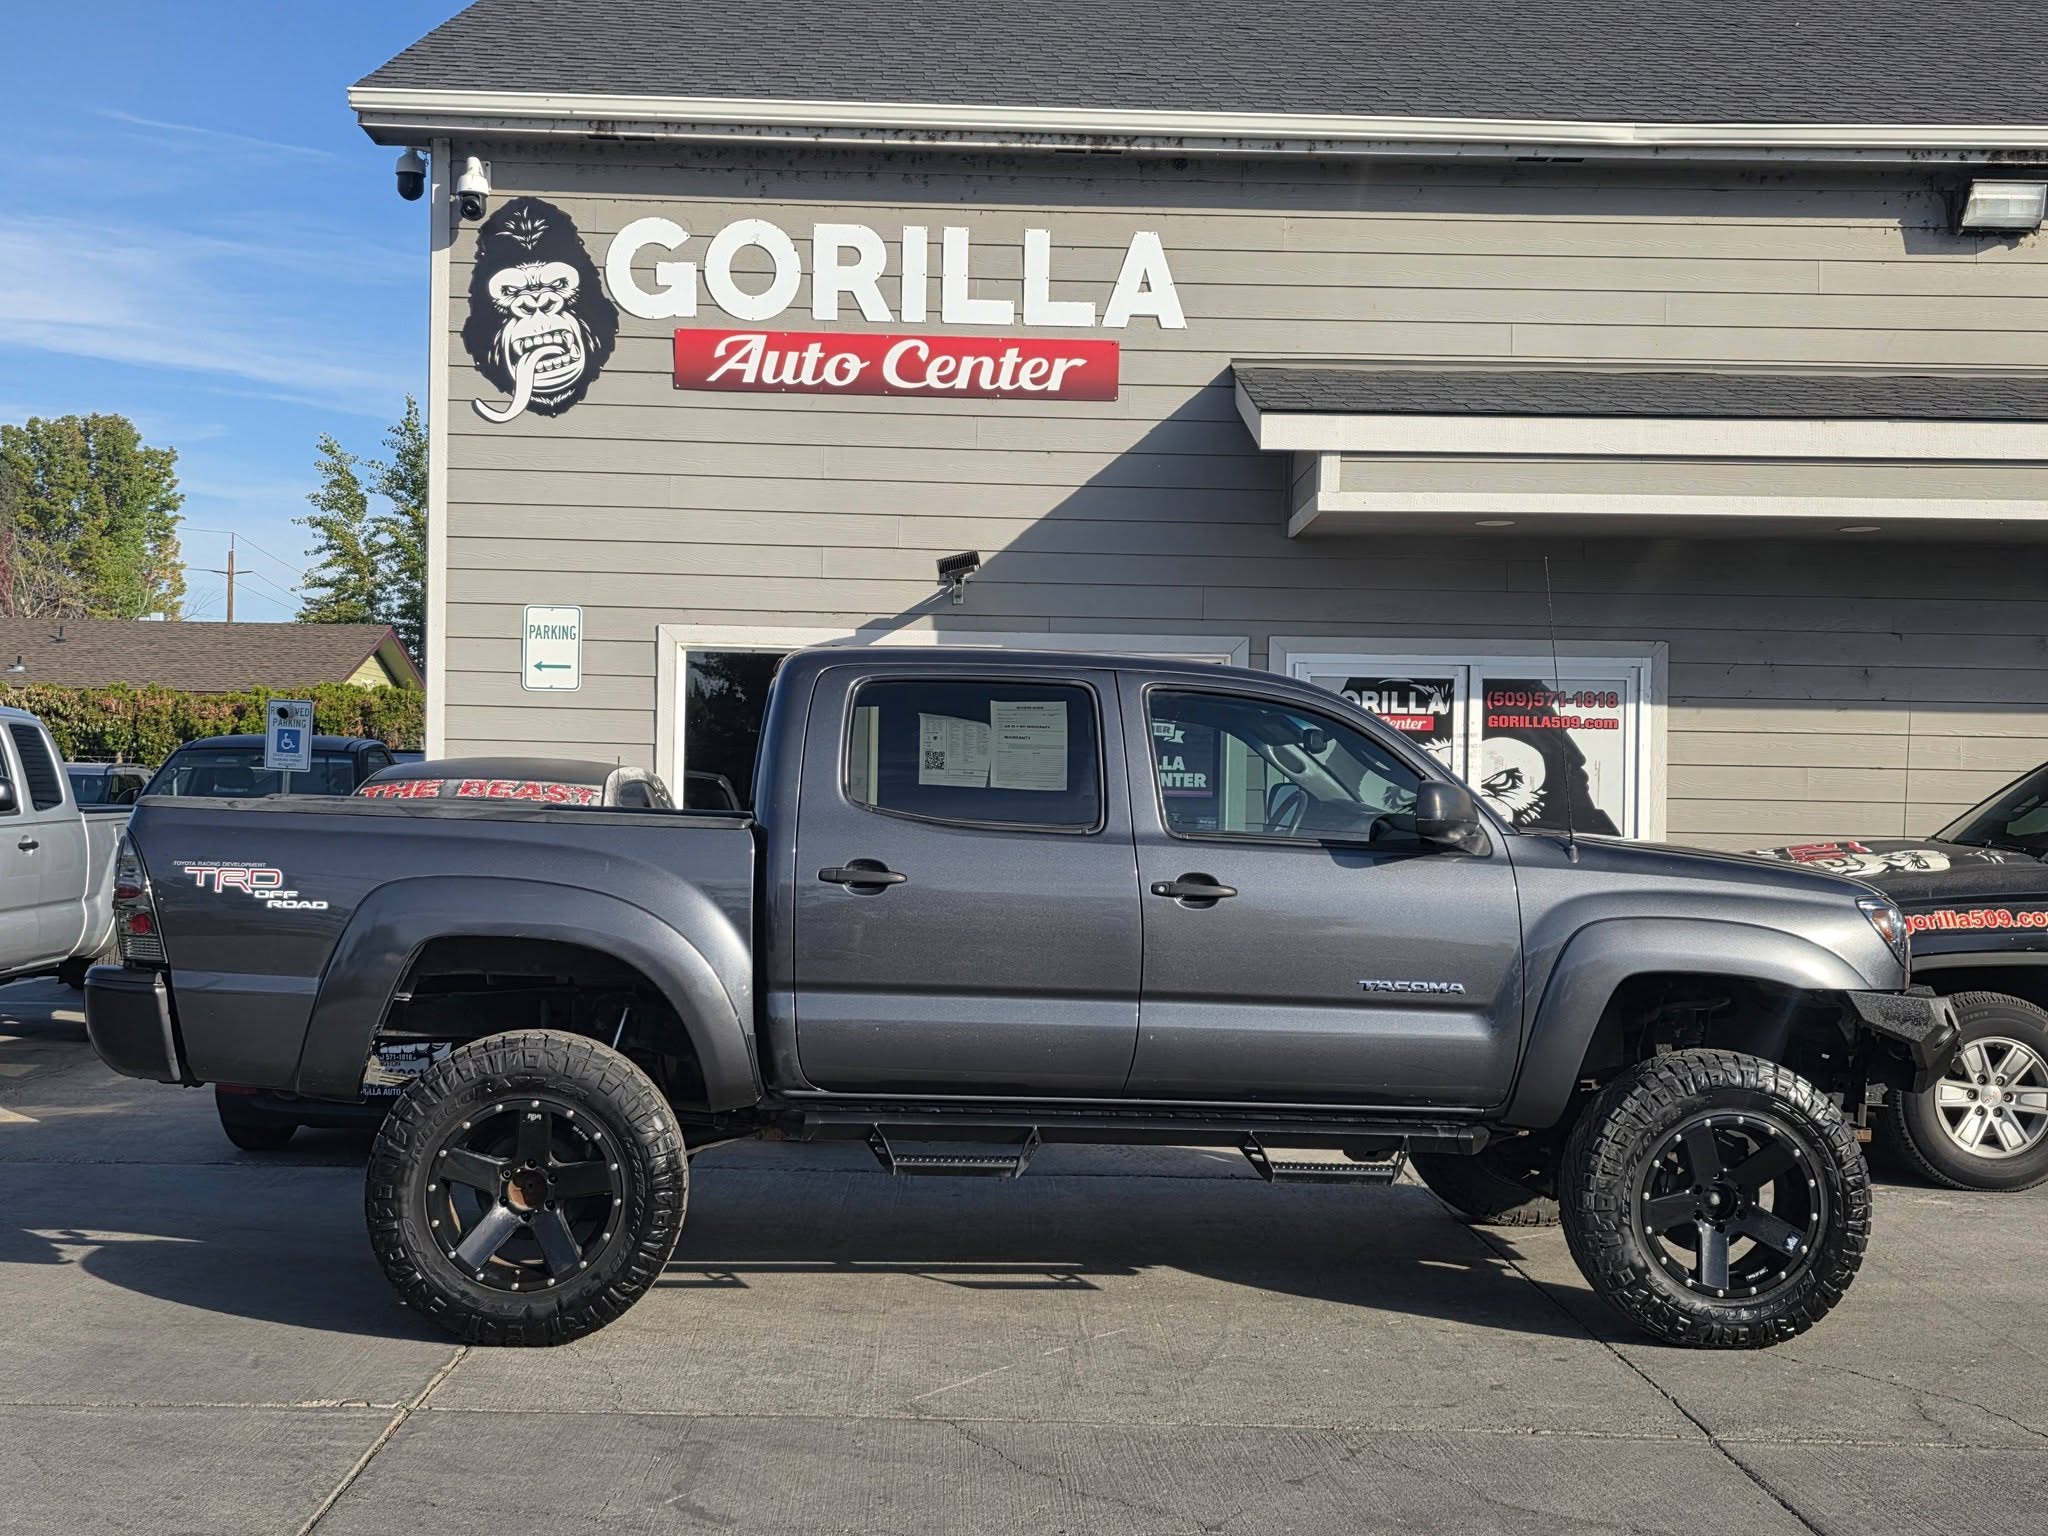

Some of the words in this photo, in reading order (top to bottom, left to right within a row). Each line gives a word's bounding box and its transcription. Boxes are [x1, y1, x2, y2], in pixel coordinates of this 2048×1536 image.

[604, 216, 1188, 330] GORILLA
[706, 334, 871, 387] Auto
[882, 338, 1088, 392] Center
[529, 624, 577, 641] PARKING
[1487, 690, 1619, 710] (509)571-1818
[272, 717, 307, 728] PARKING
[1488, 715, 1619, 729] GORILLA509.com
[360, 779, 445, 799] THE
[456, 779, 602, 805] BEAST
[184, 866, 283, 894] TRD
[253, 890, 299, 899] OFF
[266, 900, 329, 909] ROAD
[1357, 980, 1466, 995] TACOMA
